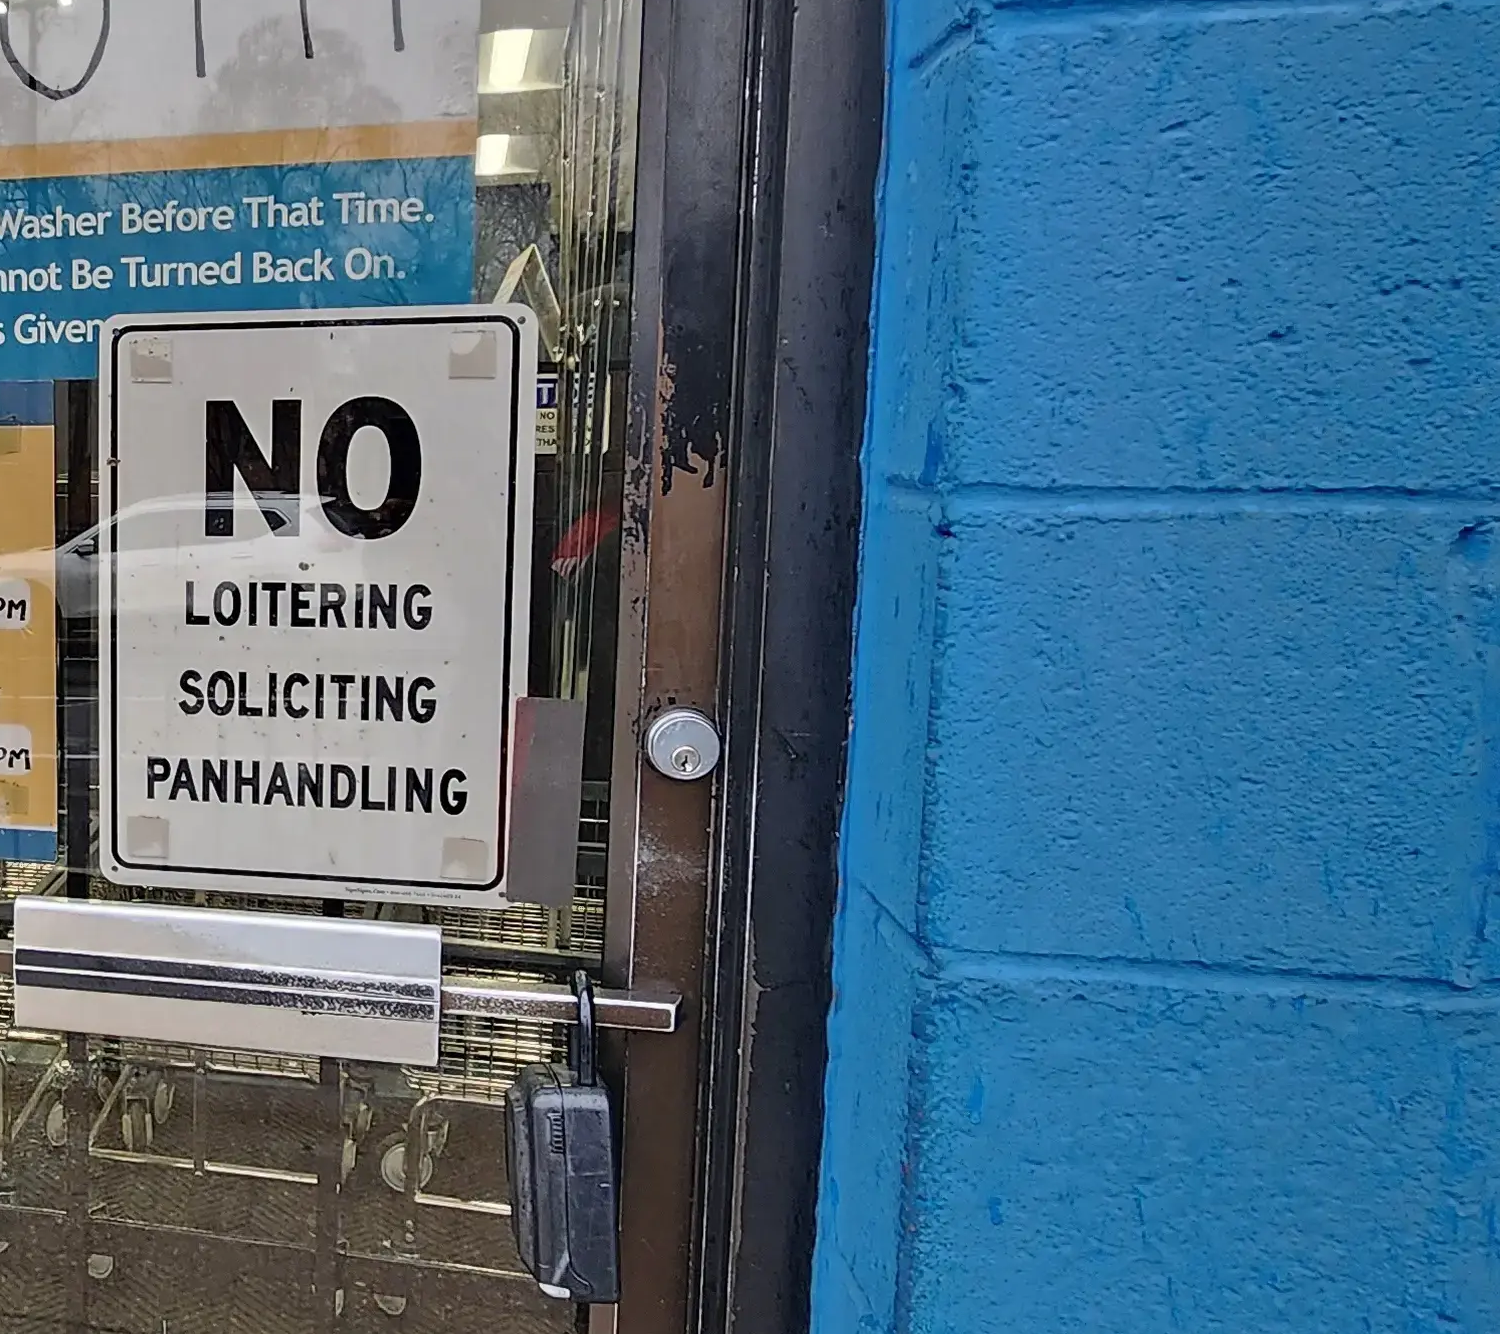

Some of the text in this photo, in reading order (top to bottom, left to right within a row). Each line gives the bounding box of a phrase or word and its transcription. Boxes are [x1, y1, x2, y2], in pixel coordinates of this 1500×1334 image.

[121, 200, 235, 234] Before
[242, 194, 325, 228] That
[332, 191, 435, 224] Time.
[71, 257, 114, 290] Be
[120, 251, 242, 288] Turned
[252, 247, 335, 284] Back
[344, 246, 406, 280] On.
[205, 395, 423, 540] NO
[185, 580, 434, 631] LOITERING
[178, 669, 438, 724] SOLICITING
[146, 755, 469, 816] PANHANDLING
